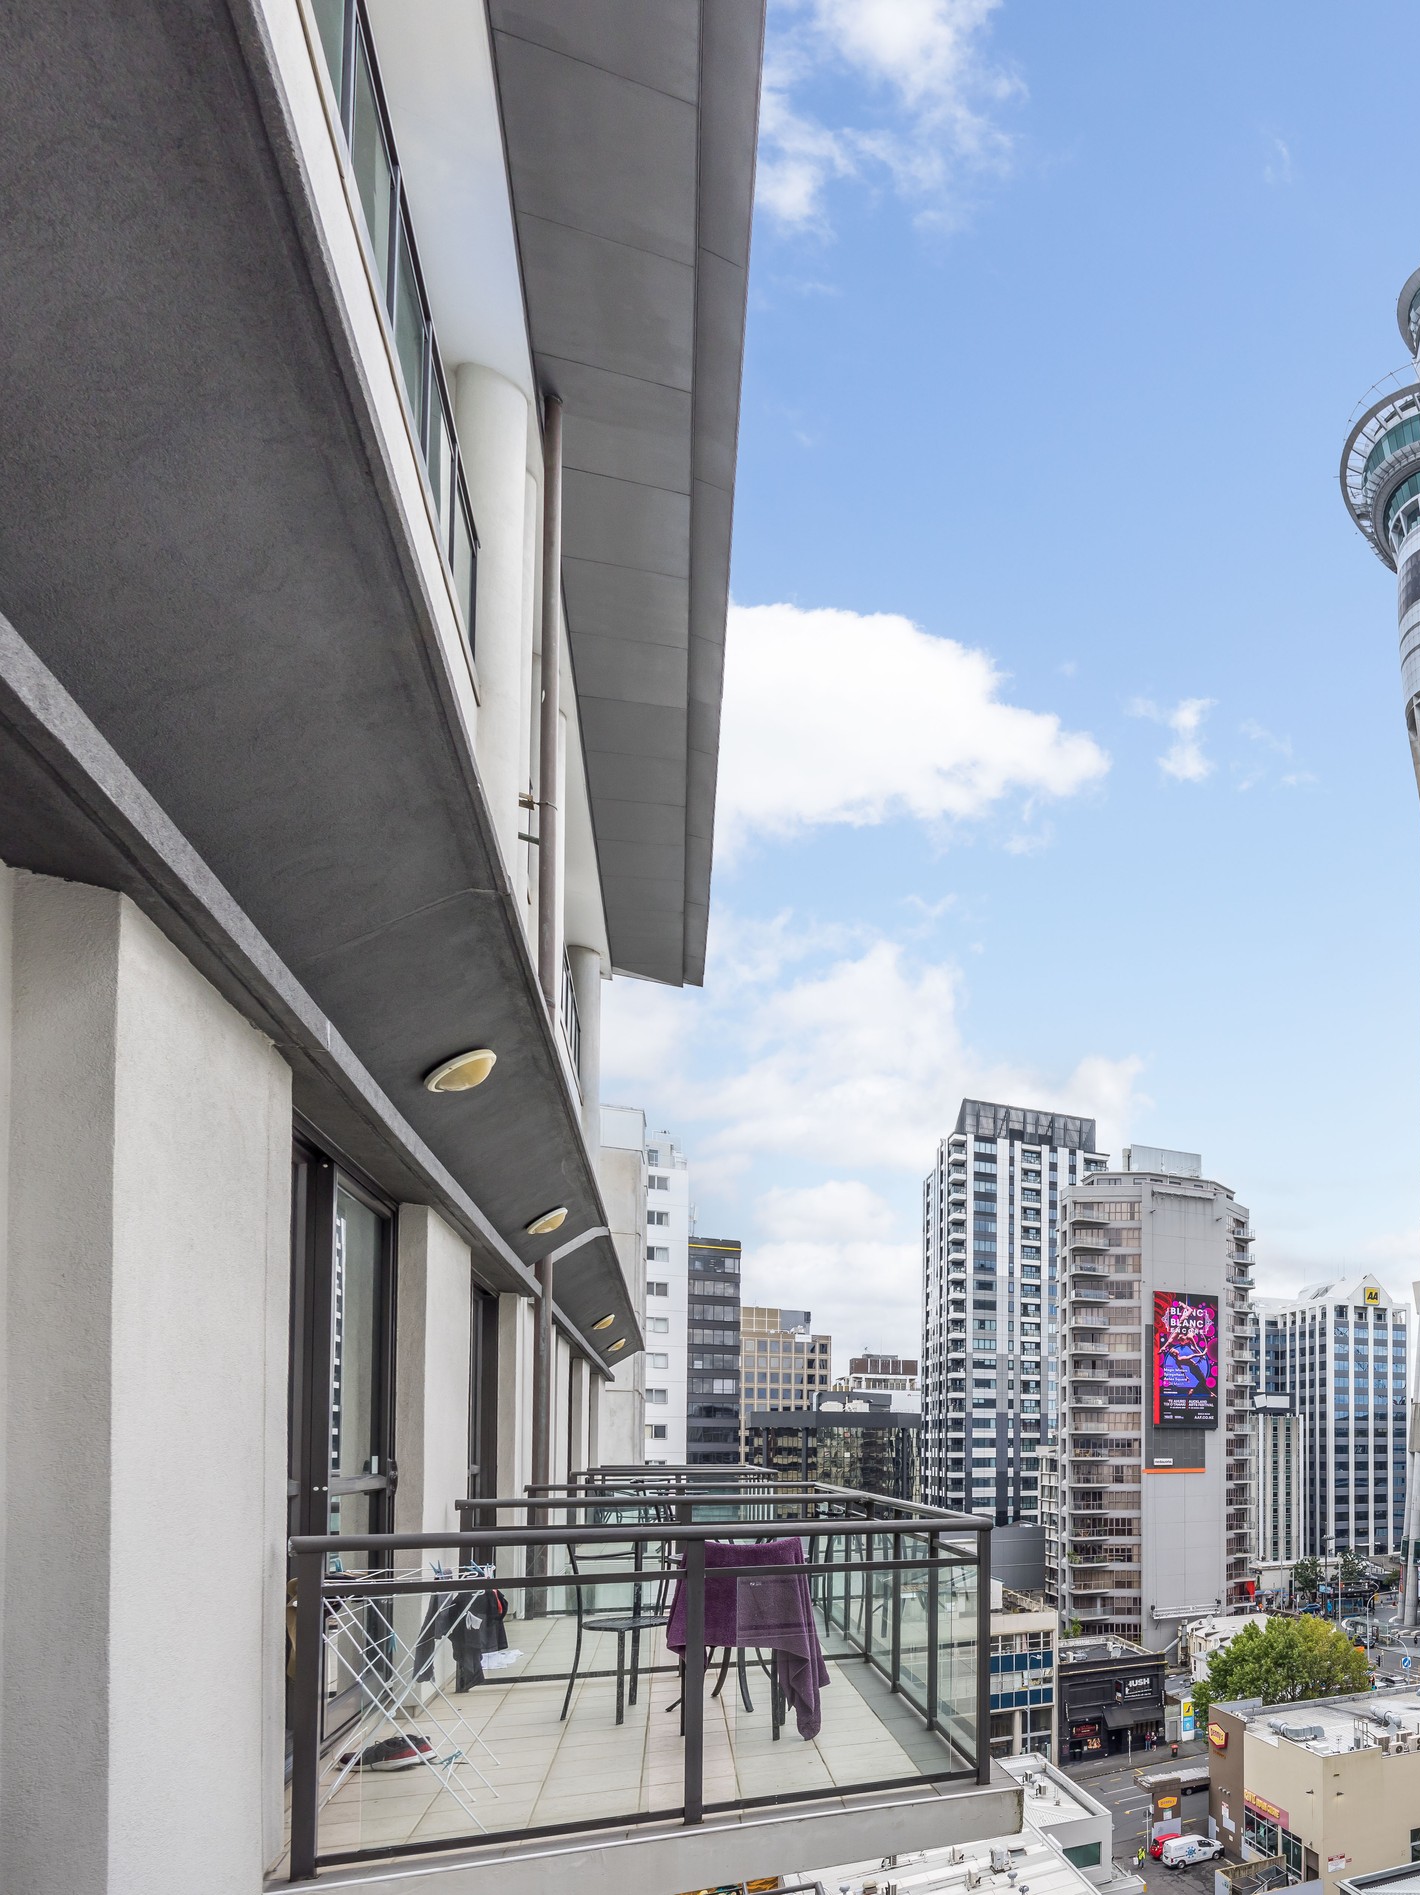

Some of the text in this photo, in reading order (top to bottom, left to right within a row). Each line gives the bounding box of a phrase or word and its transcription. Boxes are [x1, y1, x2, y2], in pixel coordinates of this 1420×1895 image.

[1367, 1291, 1378, 1300] AA
[1170, 1307, 1203, 1316] BLANC
[1170, 1319, 1203, 1327] BLANC
